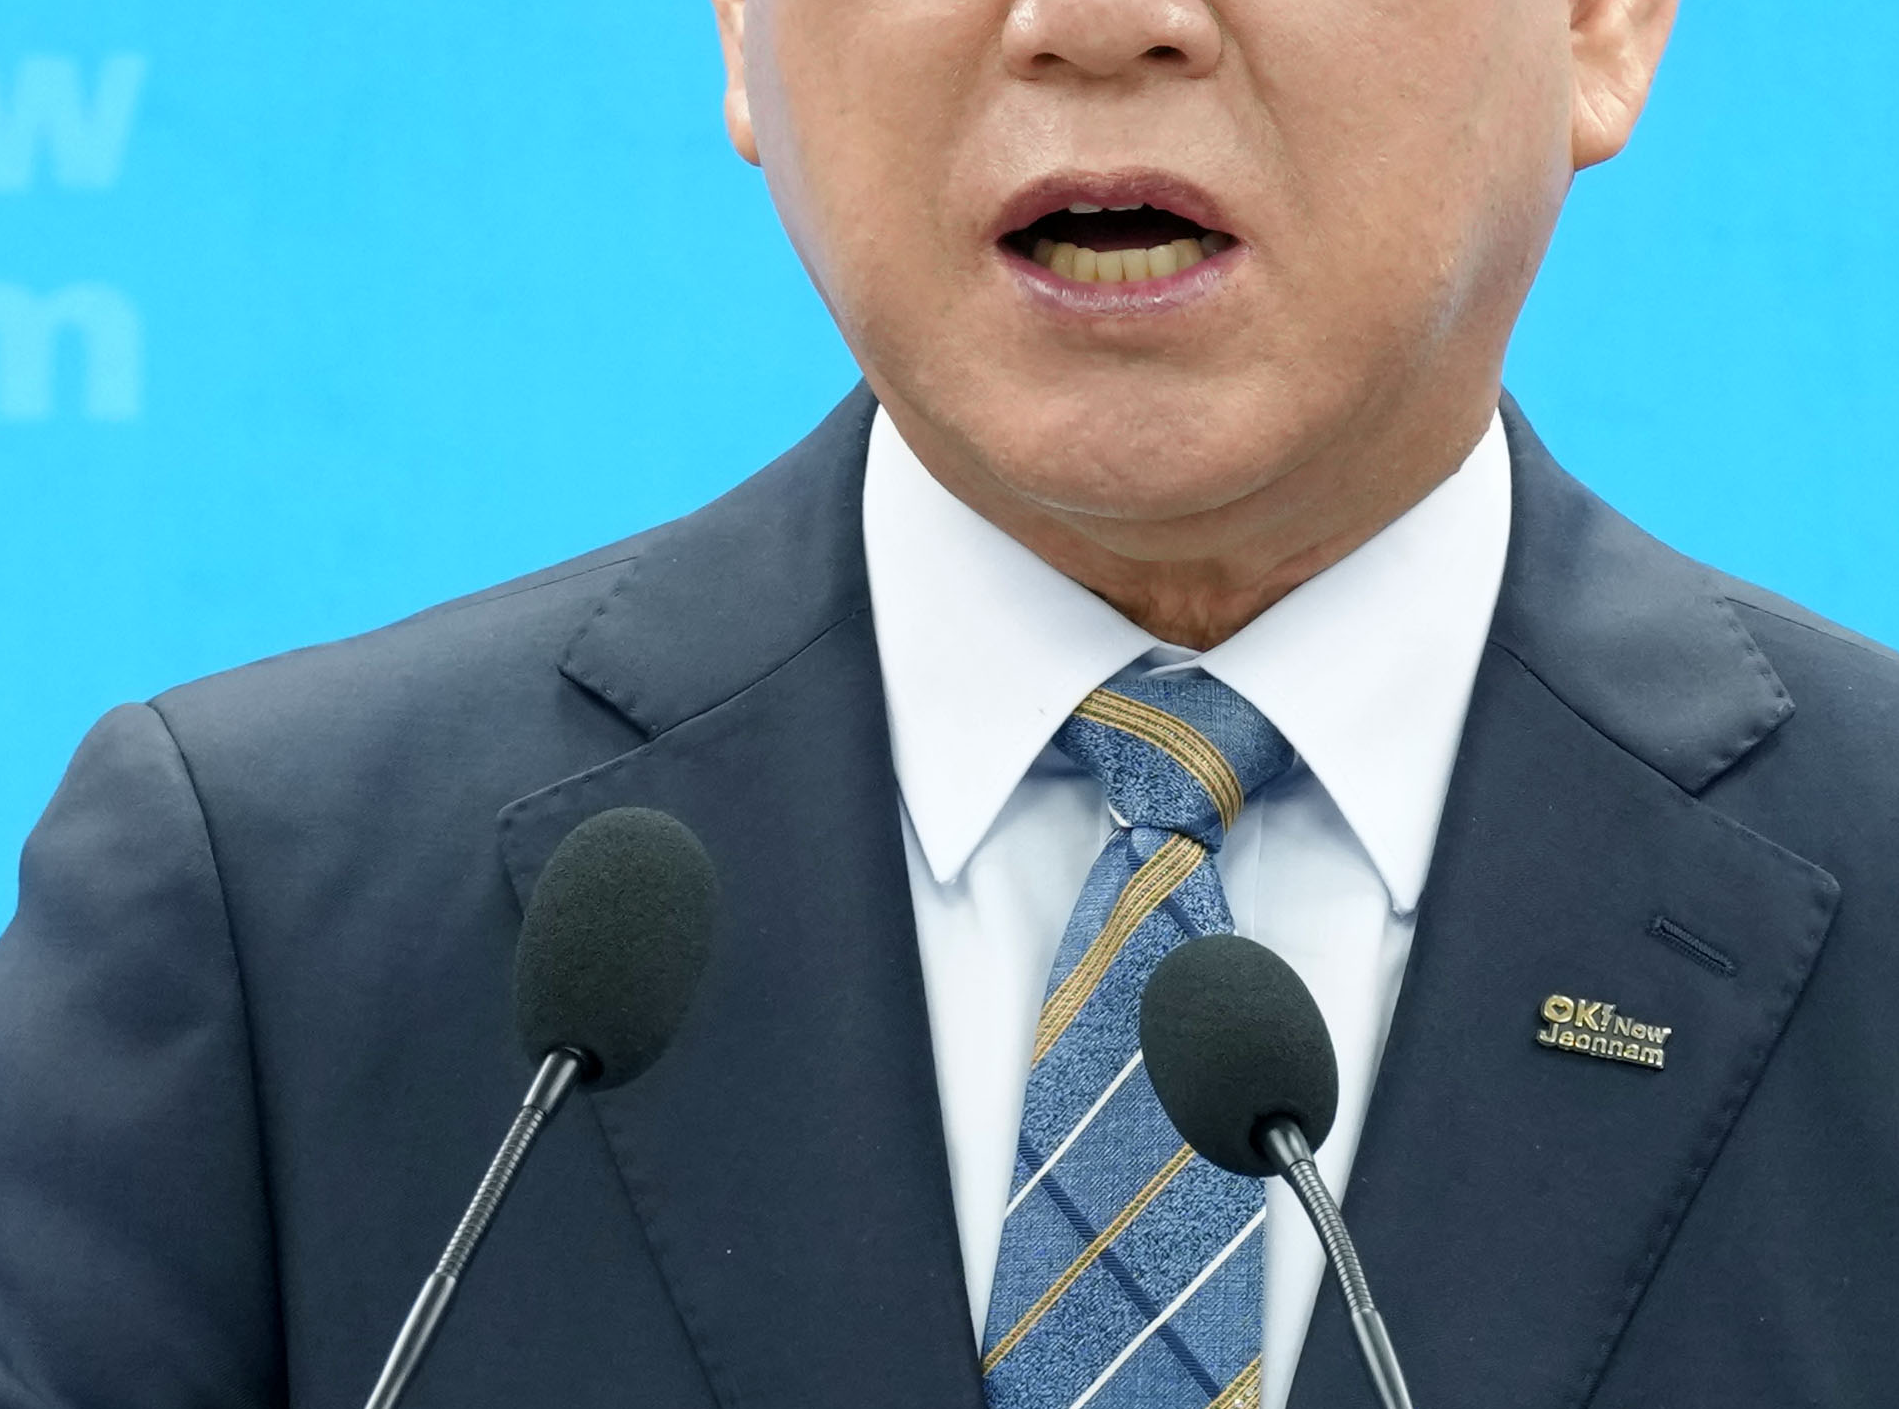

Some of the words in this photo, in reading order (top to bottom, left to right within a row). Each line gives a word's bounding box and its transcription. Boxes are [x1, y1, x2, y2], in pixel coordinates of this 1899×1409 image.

[1542, 993, 1617, 1032] OK!
[1613, 1016, 1673, 1044] Now
[1538, 1022, 1665, 1067] Jeonnam
